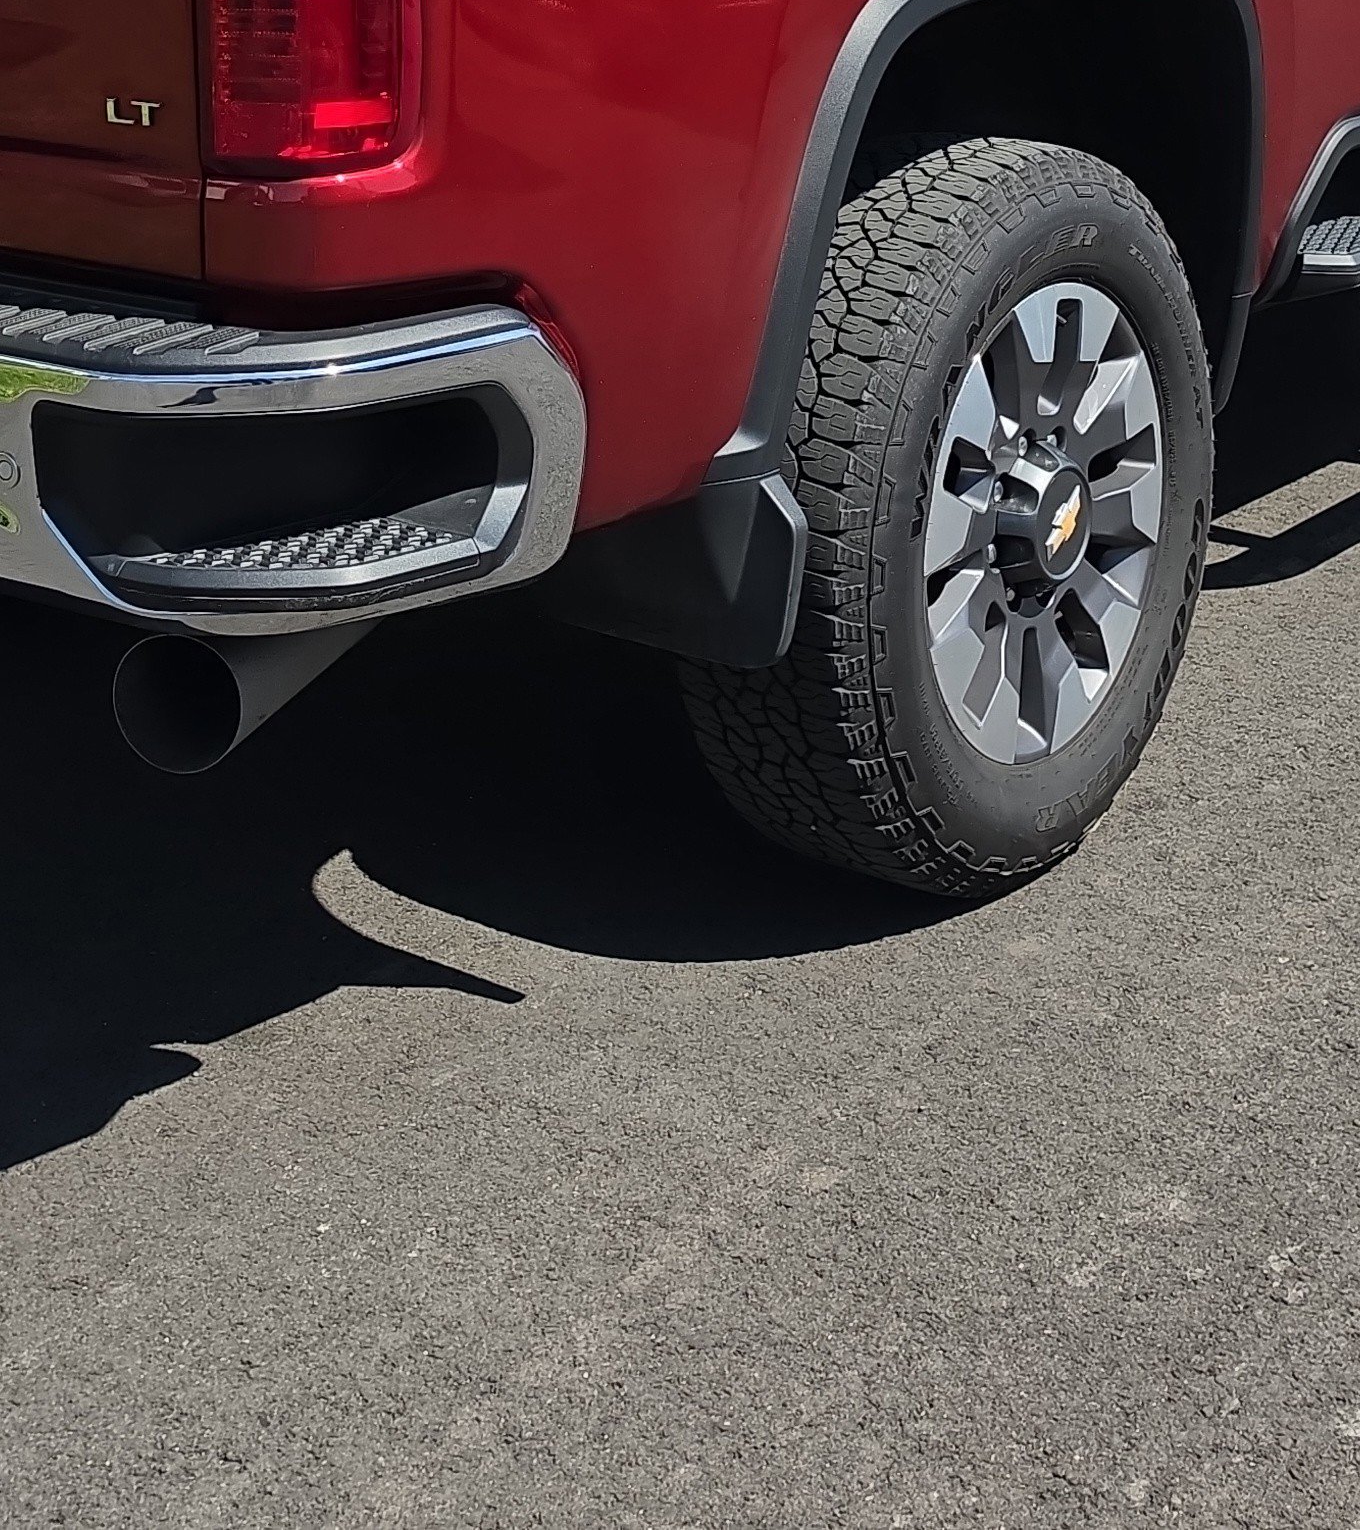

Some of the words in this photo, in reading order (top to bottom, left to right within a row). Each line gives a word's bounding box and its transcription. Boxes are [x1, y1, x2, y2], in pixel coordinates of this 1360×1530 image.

[105, 96, 162, 127] LT
[909, 222, 1099, 542] WRANGLER
[1035, 497, 1205, 833] GOODYEAR
